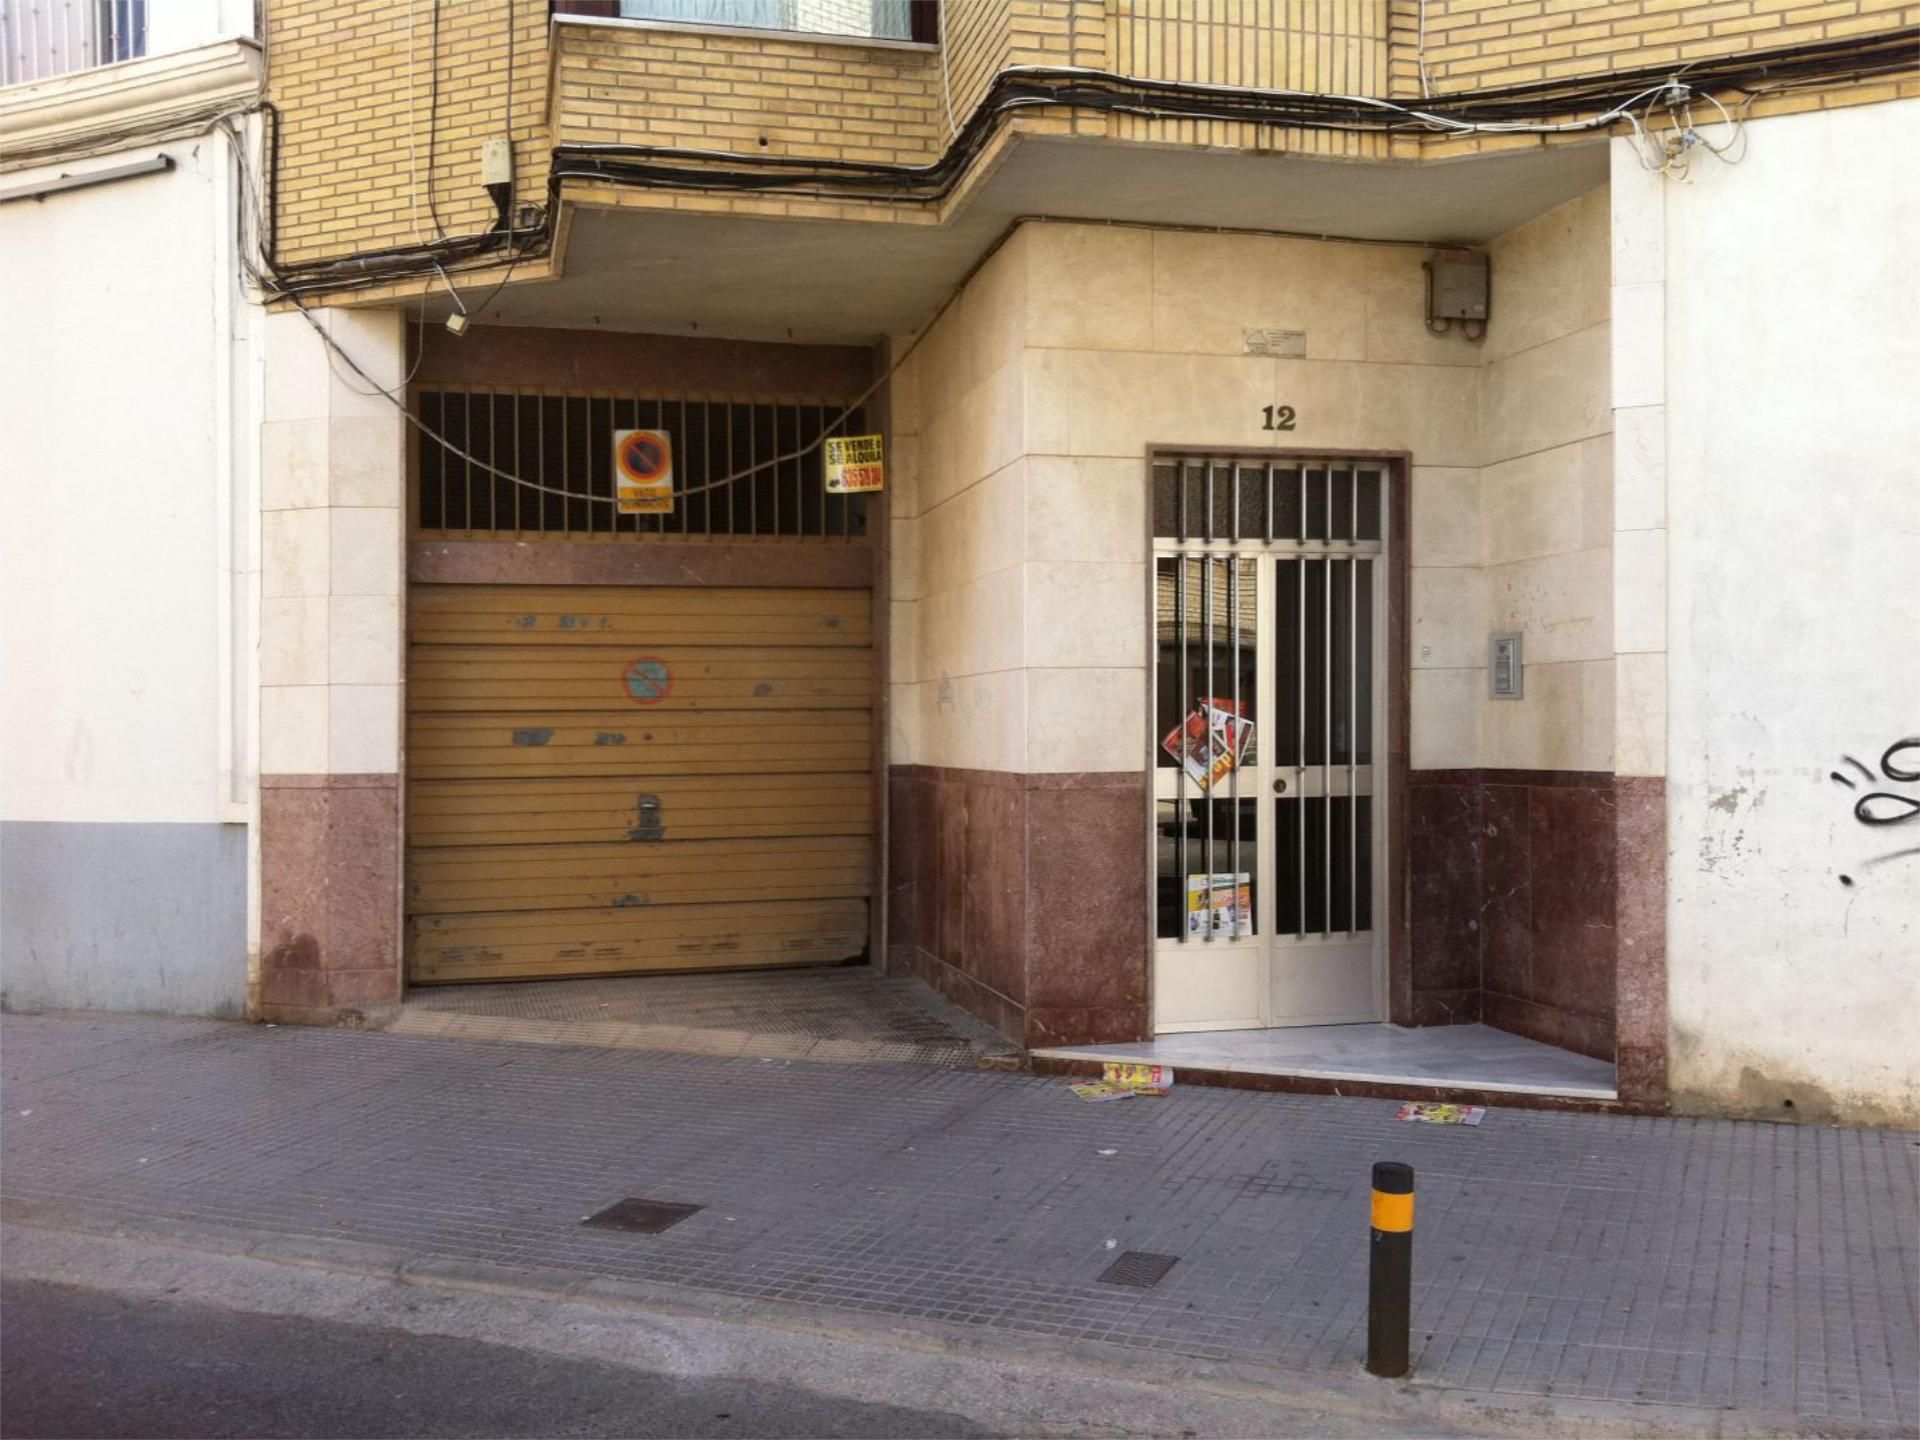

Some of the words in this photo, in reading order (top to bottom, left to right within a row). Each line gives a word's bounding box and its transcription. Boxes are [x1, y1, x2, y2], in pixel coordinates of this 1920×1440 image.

[1262, 405, 1296, 431] 12
[828, 441, 842, 452] SE
[845, 438, 874, 451] VENDE
[829, 453, 844, 465] SE
[846, 450, 881, 464] ALQUILA
